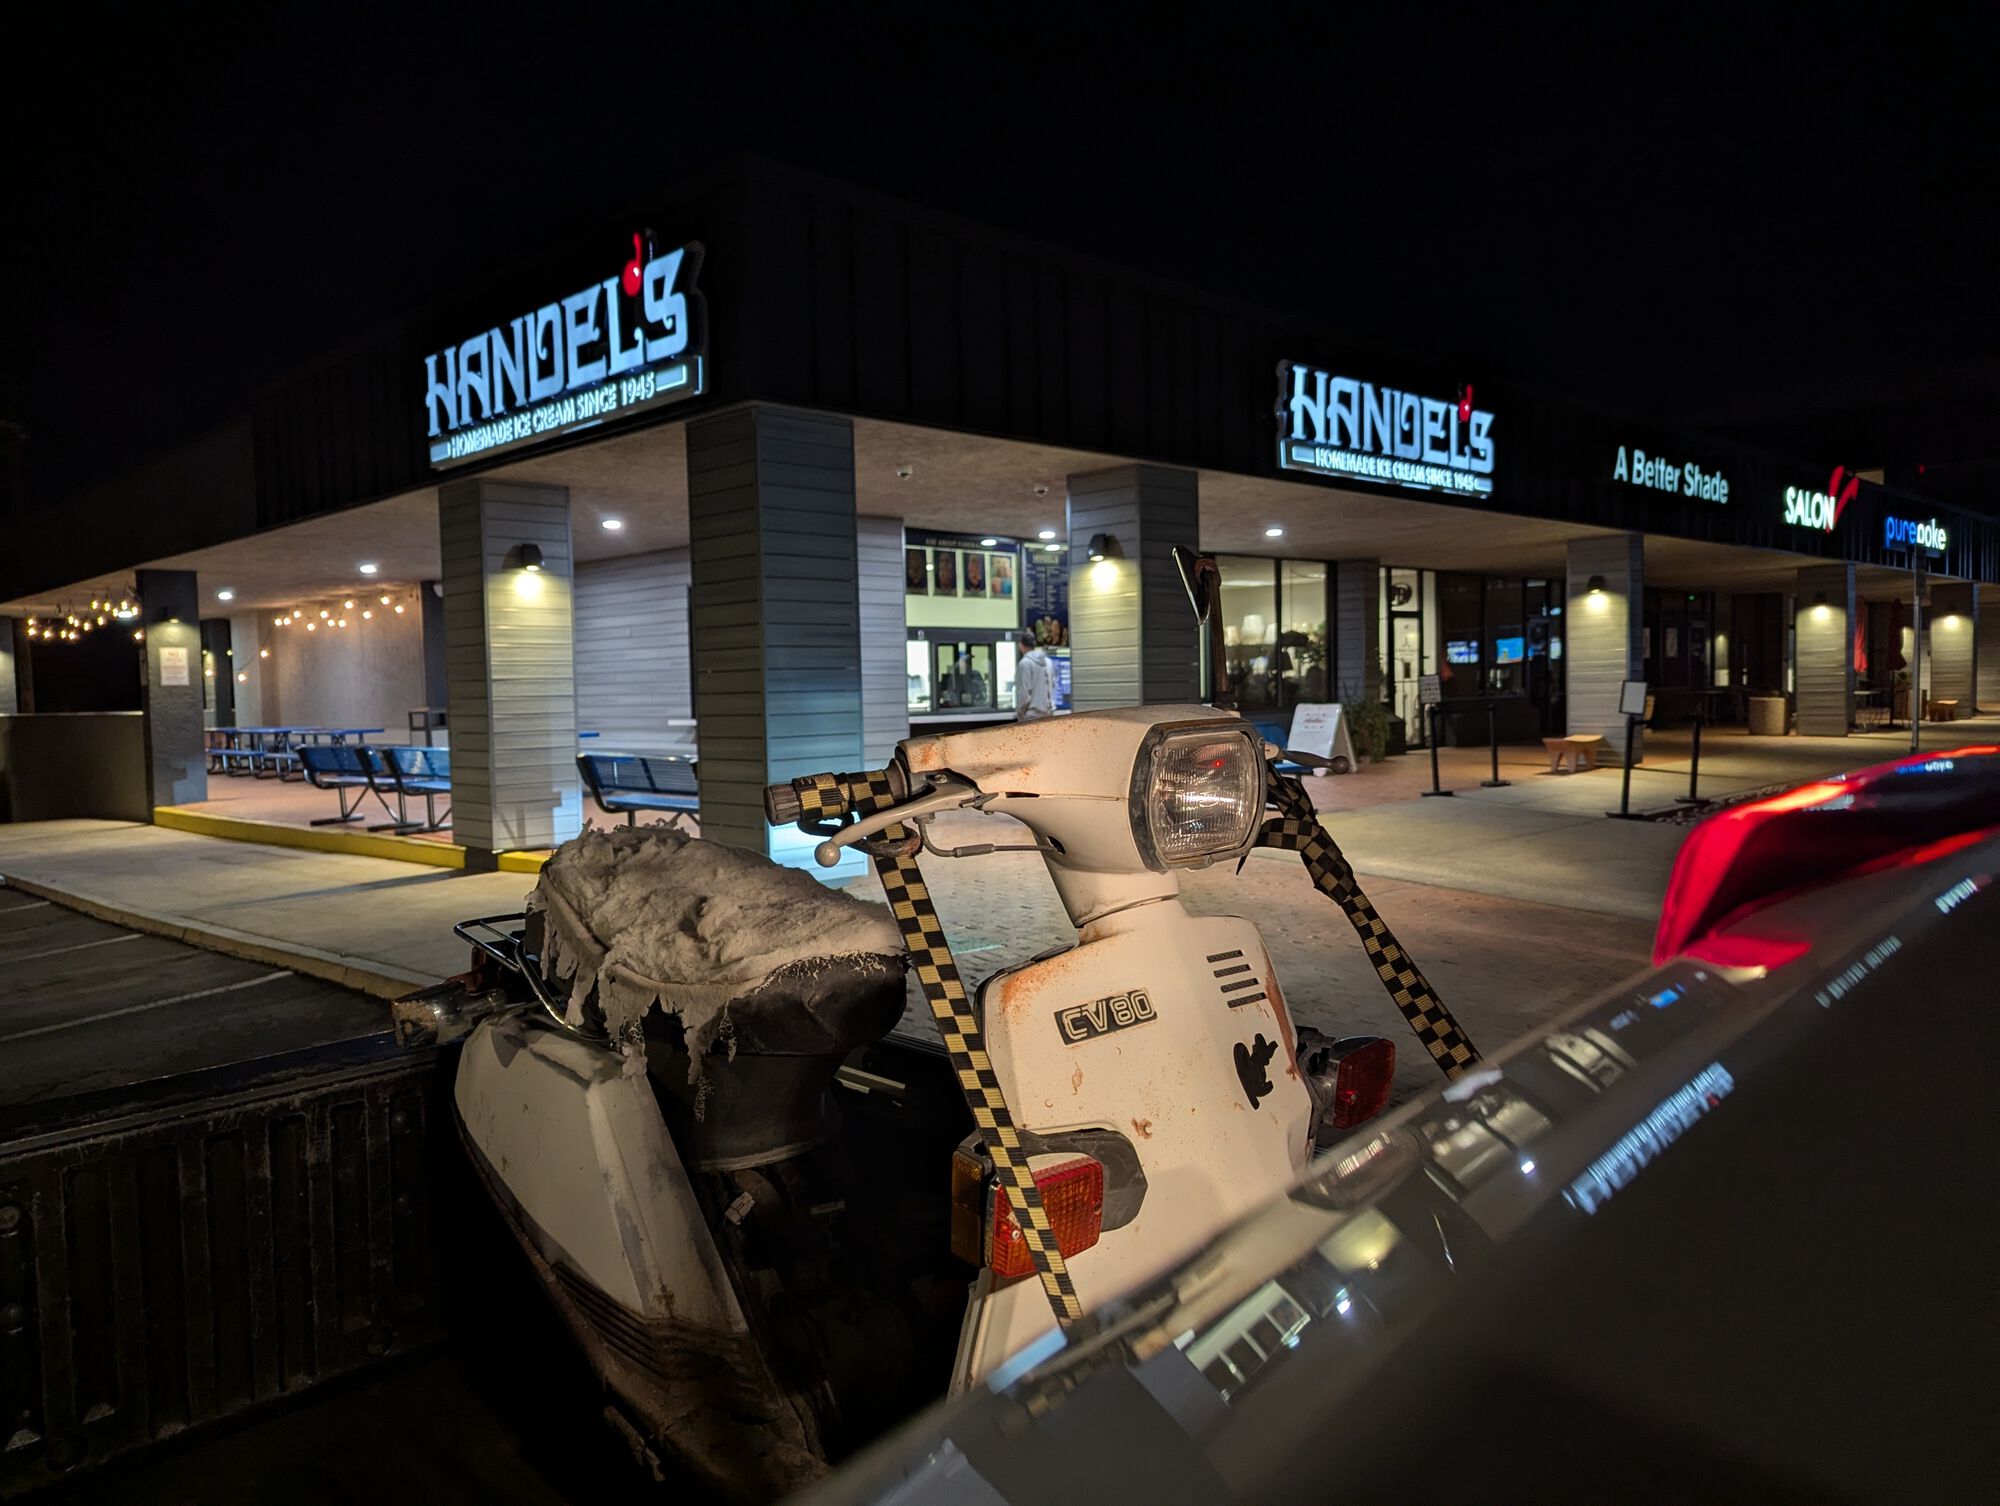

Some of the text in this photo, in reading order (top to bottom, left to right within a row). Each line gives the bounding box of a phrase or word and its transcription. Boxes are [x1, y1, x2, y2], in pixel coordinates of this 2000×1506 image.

[451, 372, 656, 459] HOMEMADE ICE CREAM SINCE 1945
[1315, 447, 1475, 492] HOMEMADE ICE CREAM SINCE 1945
[1613, 445, 1729, 504] A Better Shade
[1784, 486, 1836, 531] SALON
[1060, 989, 1156, 1041] CV80
